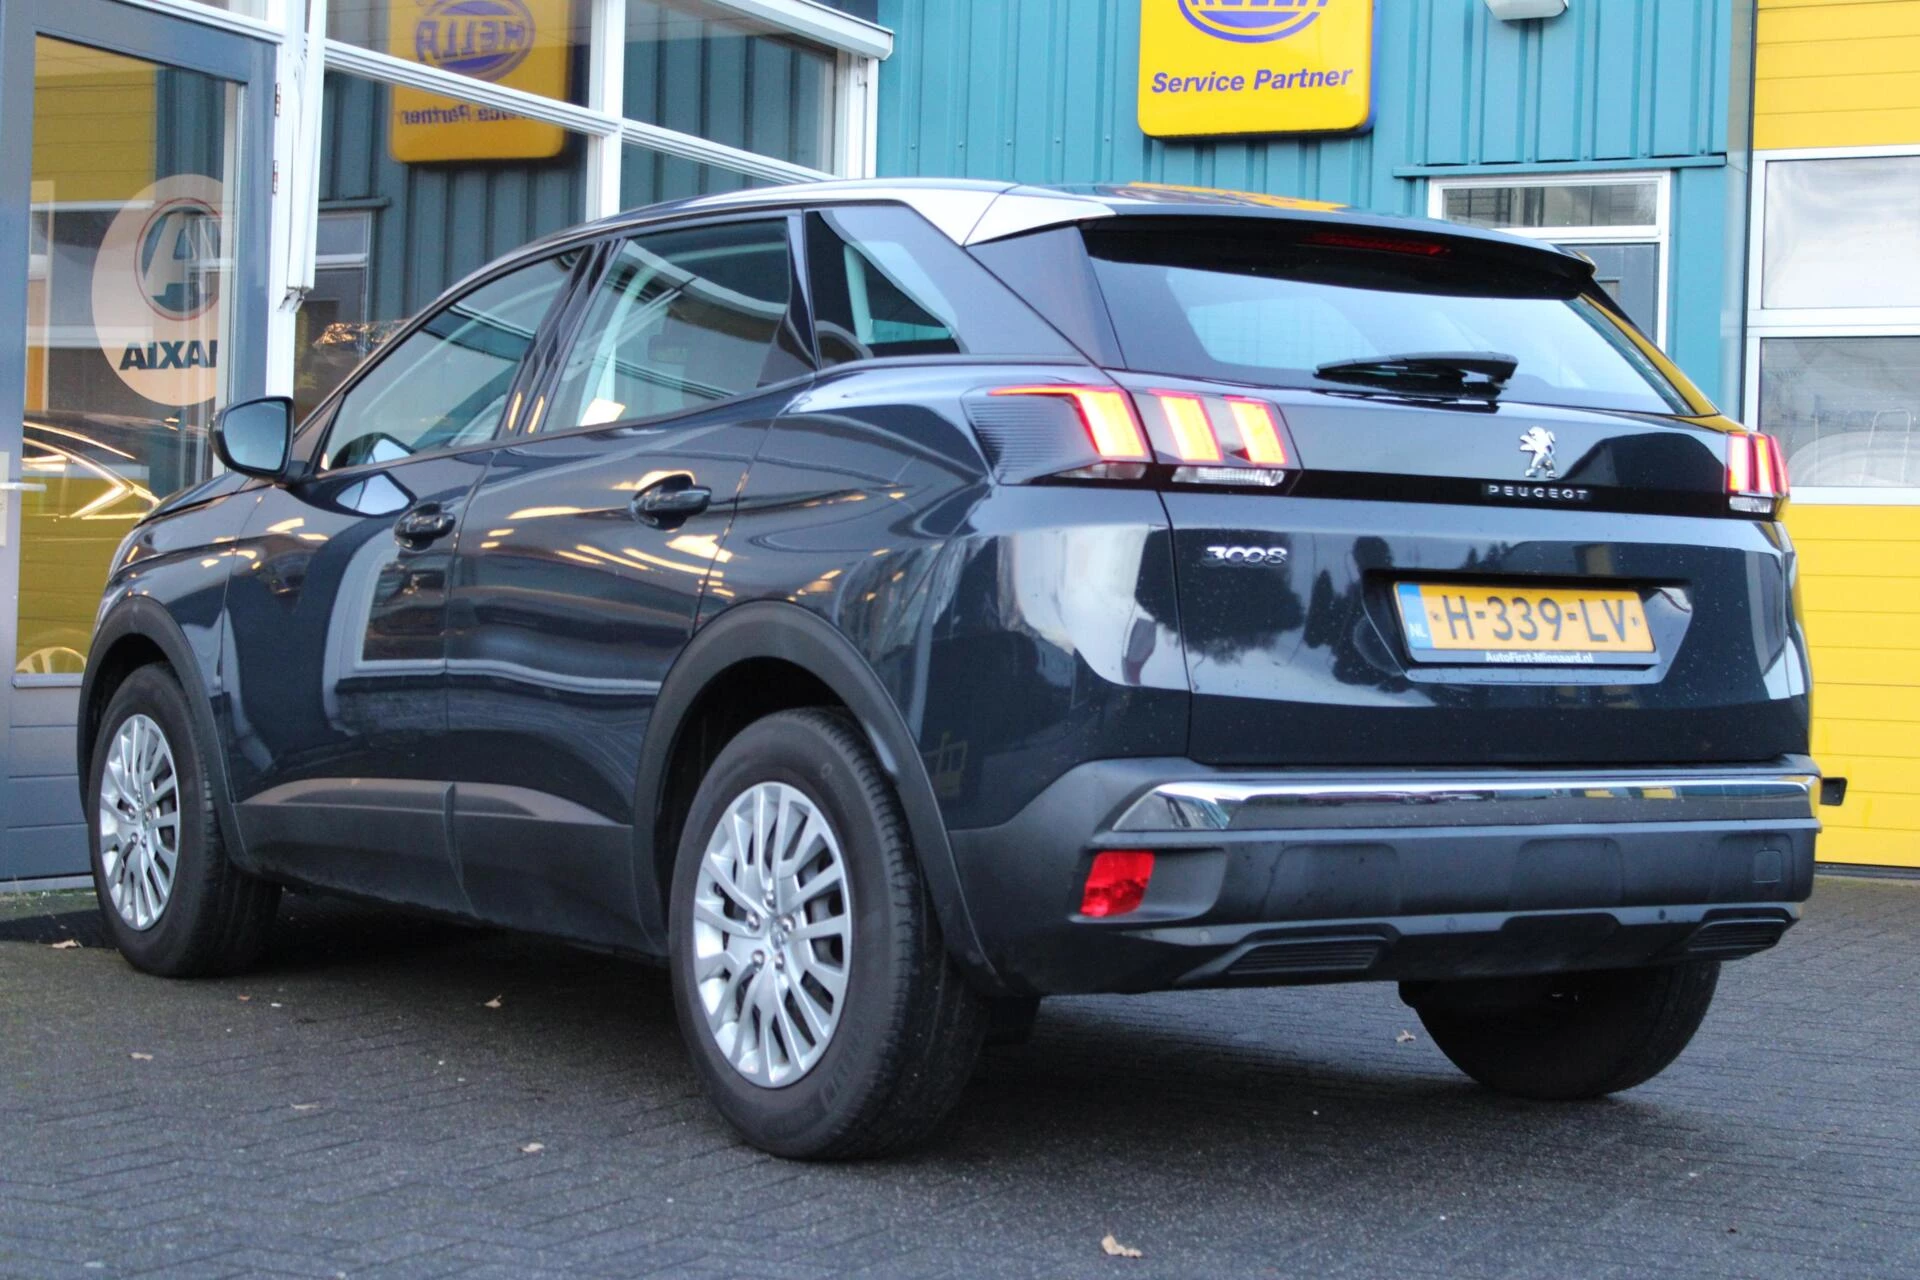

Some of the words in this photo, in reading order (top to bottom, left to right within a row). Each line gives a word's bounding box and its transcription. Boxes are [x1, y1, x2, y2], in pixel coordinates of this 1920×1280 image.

[1151, 71, 1245, 94] Service
[1253, 68, 1353, 91] Partner
[118, 339, 218, 371] AIXA
[1488, 484, 1588, 500] PEUGEOT
[1203, 545, 1288, 567] 3008
[1441, 594, 1626, 642] H-339-LV
[1408, 622, 1429, 639] NL
